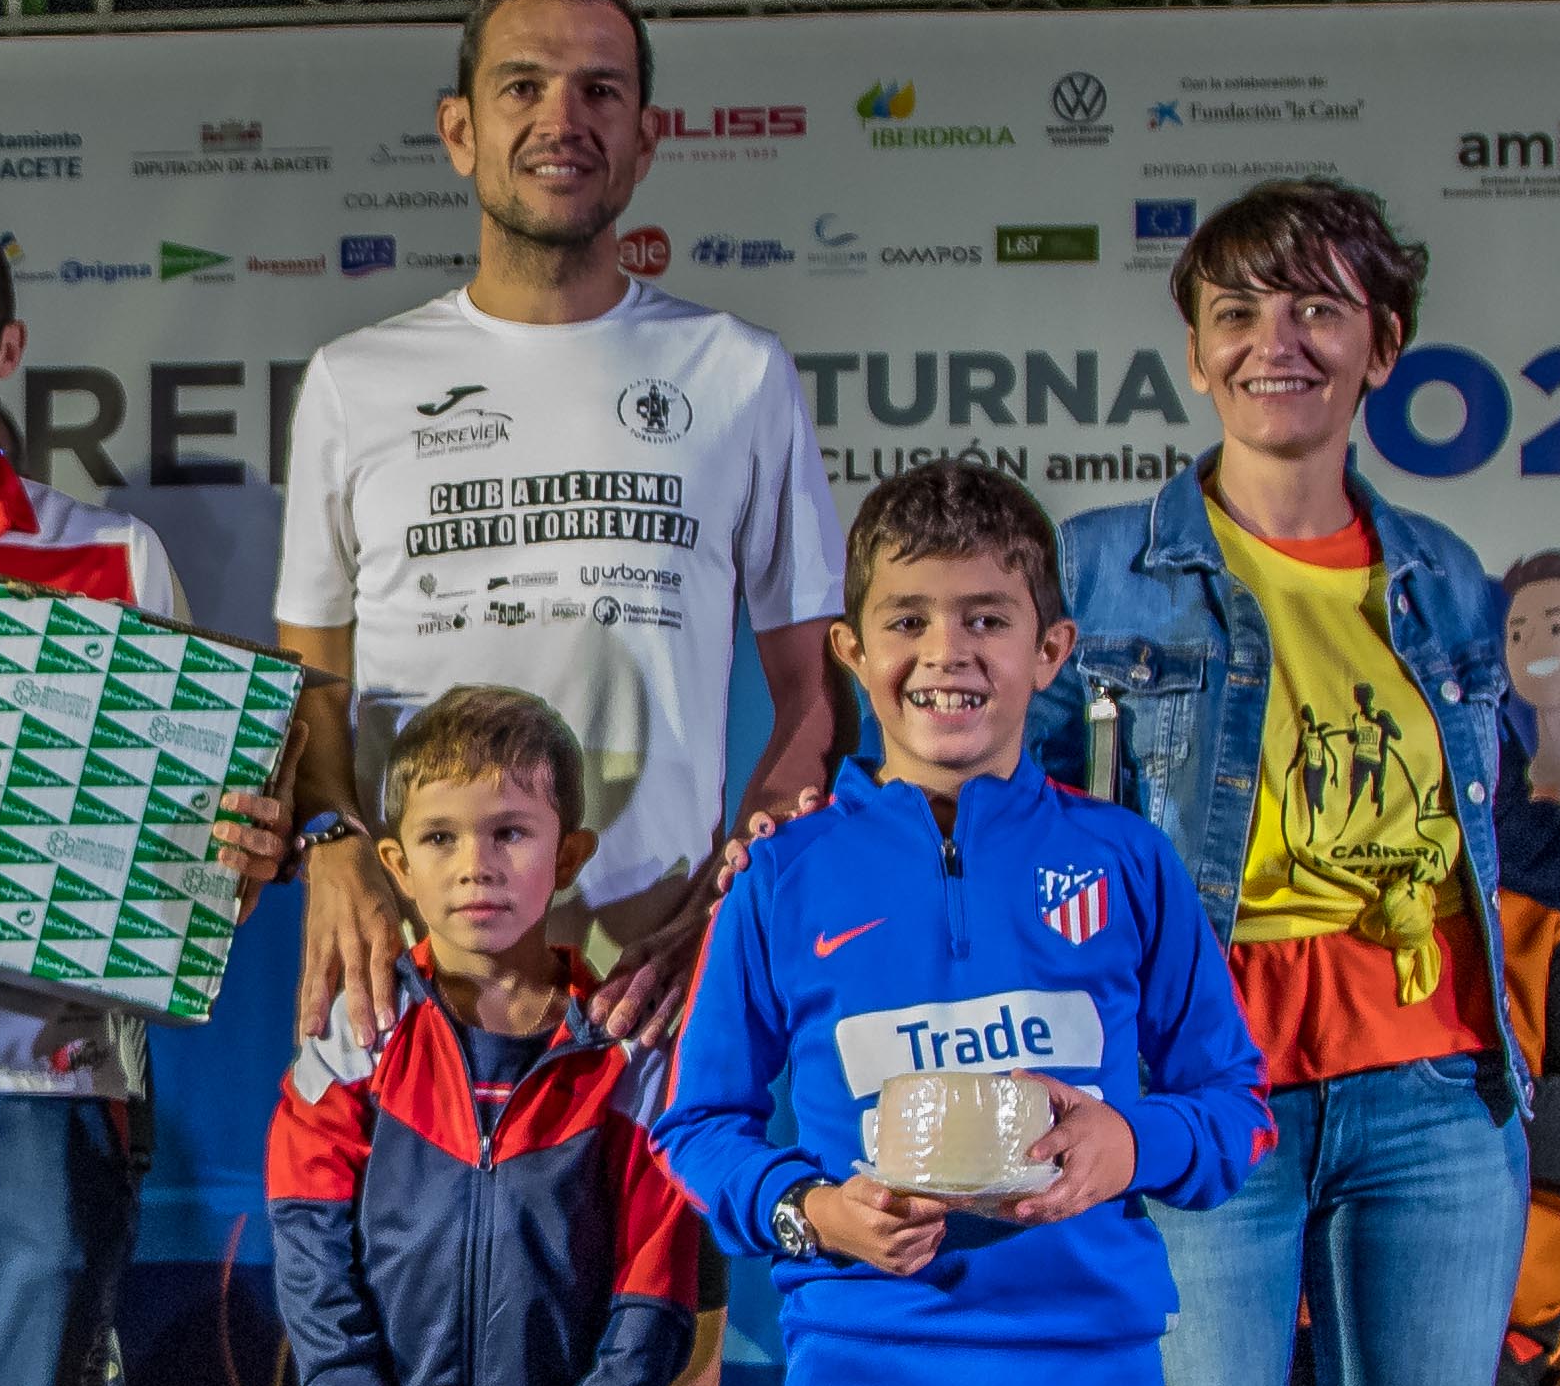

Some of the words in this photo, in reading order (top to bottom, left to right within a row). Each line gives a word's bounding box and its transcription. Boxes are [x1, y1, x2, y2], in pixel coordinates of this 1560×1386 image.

[1209, 76, 1222, 89] la
[1190, 101, 1281, 121] Fundación
[872, 125, 1016, 149] IBERDROLA
[343, 191, 469, 210] COLABORAN
[619, 239, 666, 269] aje
[881, 245, 982, 266] CAMPOS
[1007, 236, 1042, 255] L&T
[797, 348, 1190, 428] TURNA
[412, 421, 509, 450] TORREVIEJA
[821, 438, 1027, 481] CLUSIÓN
[1046, 445, 1193, 482] amiab
[431, 479, 504, 514] CLUB
[512, 471, 682, 507] ATLETISMO
[407, 515, 517, 558] PUERTO
[523, 508, 699, 550] TORREVIEJA
[601, 564, 682, 586] urbanise
[1330, 842, 1440, 868] CARRERA
[897, 1004, 1054, 1072] Trade
